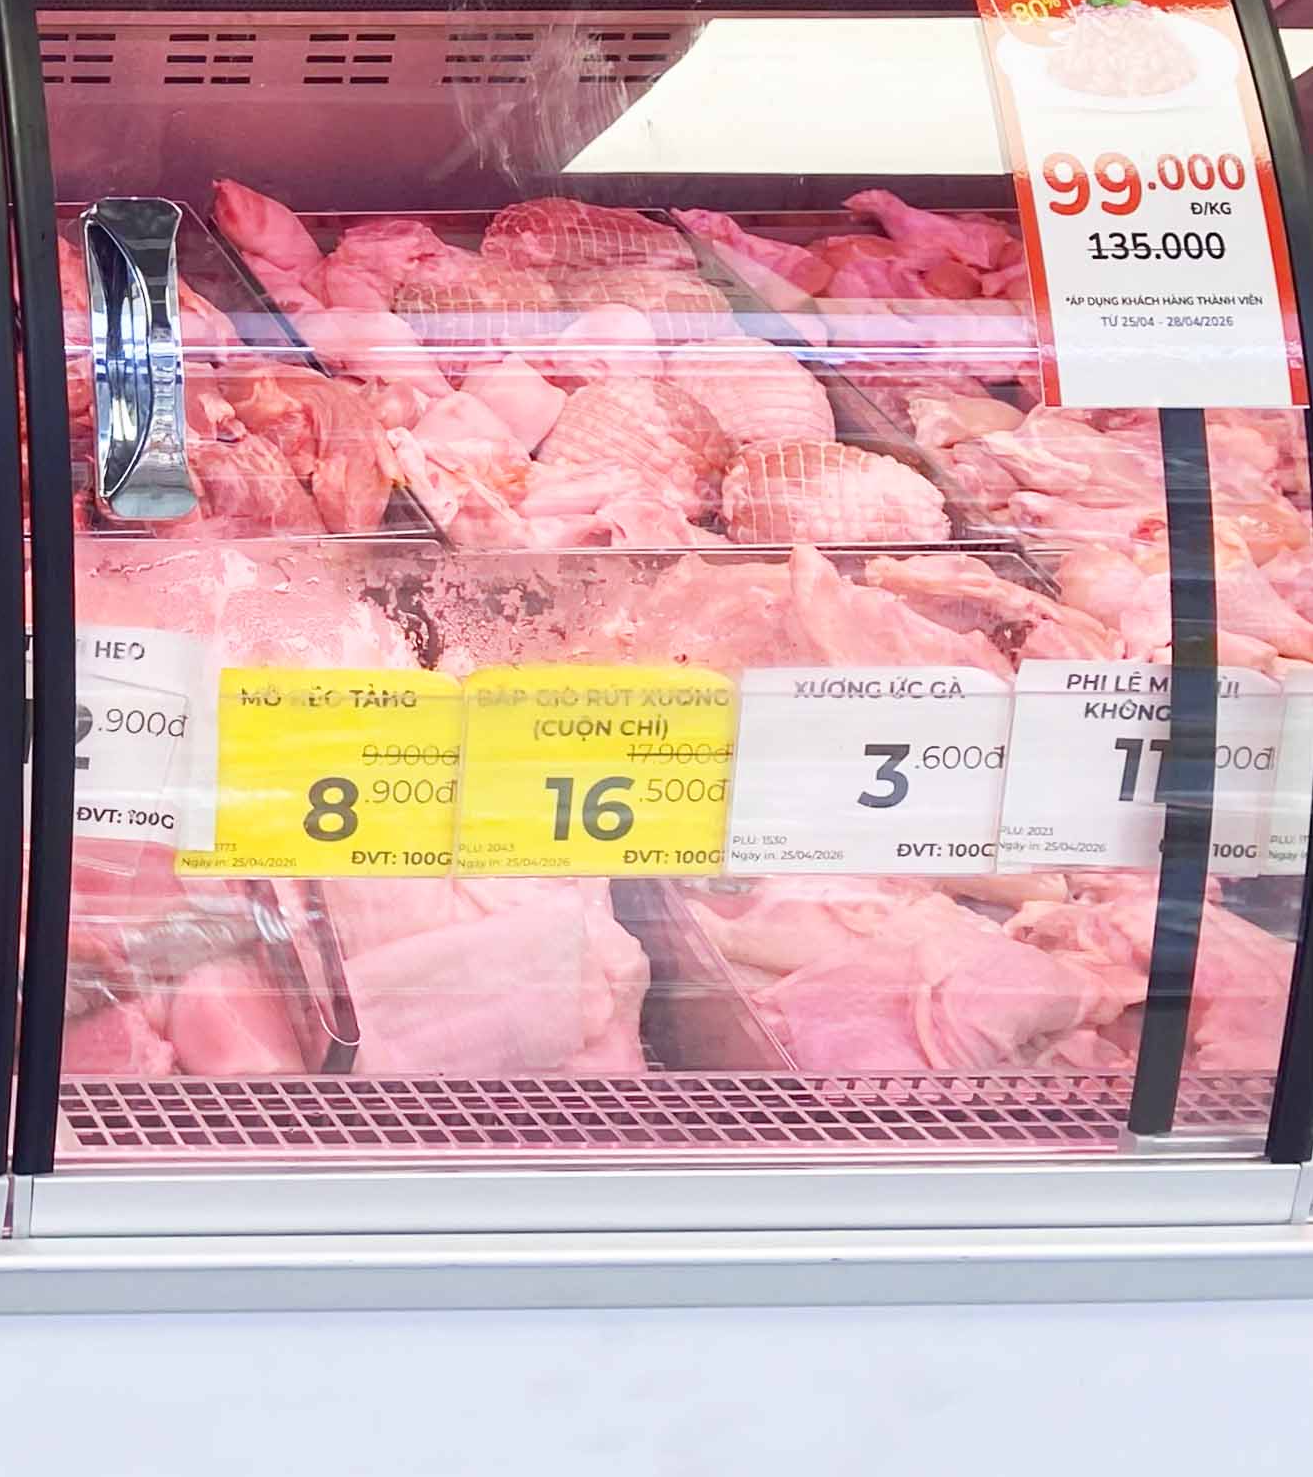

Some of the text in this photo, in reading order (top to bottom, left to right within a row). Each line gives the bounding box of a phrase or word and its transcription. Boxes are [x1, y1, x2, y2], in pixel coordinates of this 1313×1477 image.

[1042, 152, 1246, 216] 99.000
[1190, 201, 1233, 216] Đ/KG
[1087, 231, 1226, 261] 135.000
[1087, 296, 1119, 308] DỤNG
[1121, 294, 1161, 307] KHÁCH
[1162, 294, 1195, 307] HÀNG
[1197, 294, 1237, 306] THÀNH
[1238, 293, 1264, 306] VIÊN
[1121, 316, 1155, 328] 25/04
[1167, 315, 1235, 328] 28/04/2026
[794, 678, 881, 699] XƯƠNG
[930, 676, 966, 699] GÀ
[533, 719, 612, 742] (CUỘN
